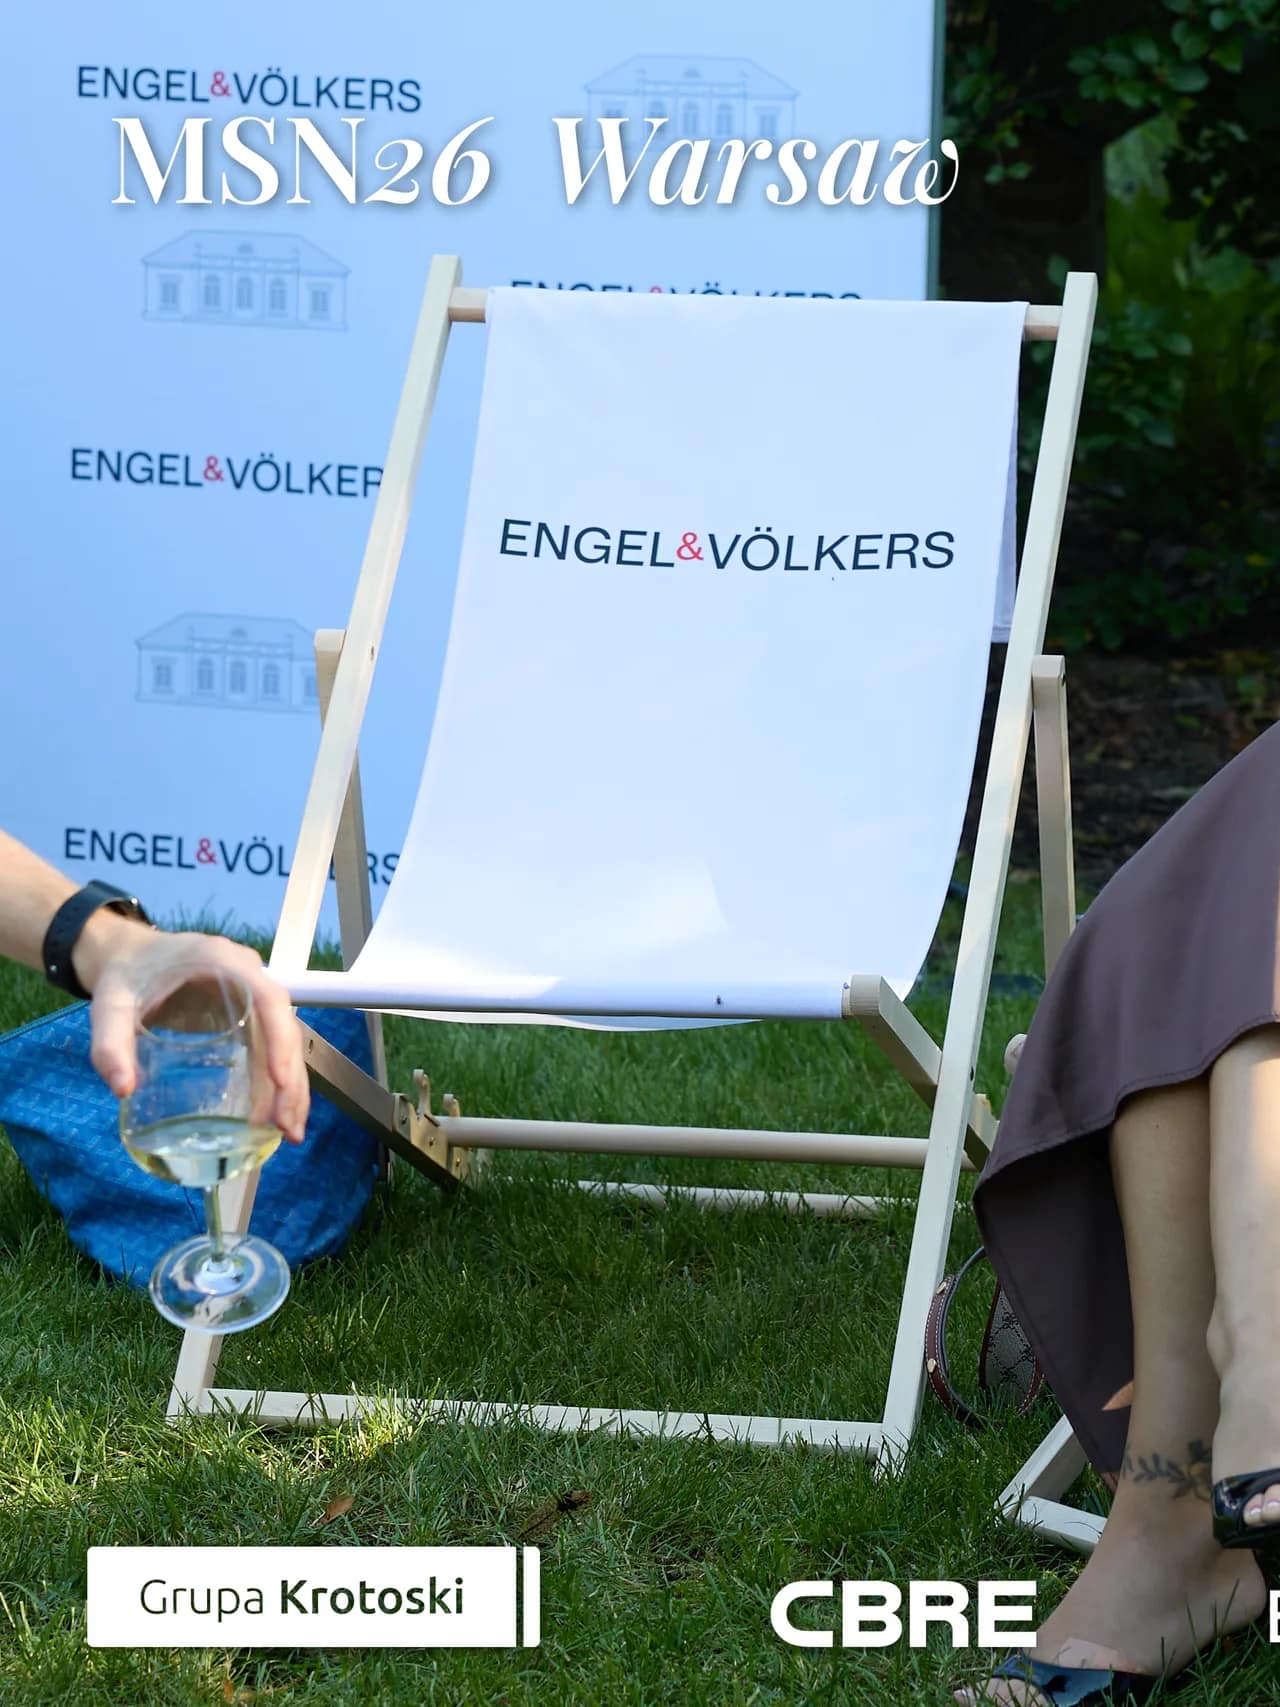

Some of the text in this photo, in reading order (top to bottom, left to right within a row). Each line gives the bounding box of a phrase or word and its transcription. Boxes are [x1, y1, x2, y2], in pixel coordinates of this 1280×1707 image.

[77, 65, 422, 113] ENGEL&VÖLKERS
[71, 447, 384, 498] ENGEL&VÖLKER
[500, 518, 955, 571] ENGEL&VÖLKERS
[63, 827, 401, 885] ENGEL&VÖLRS
